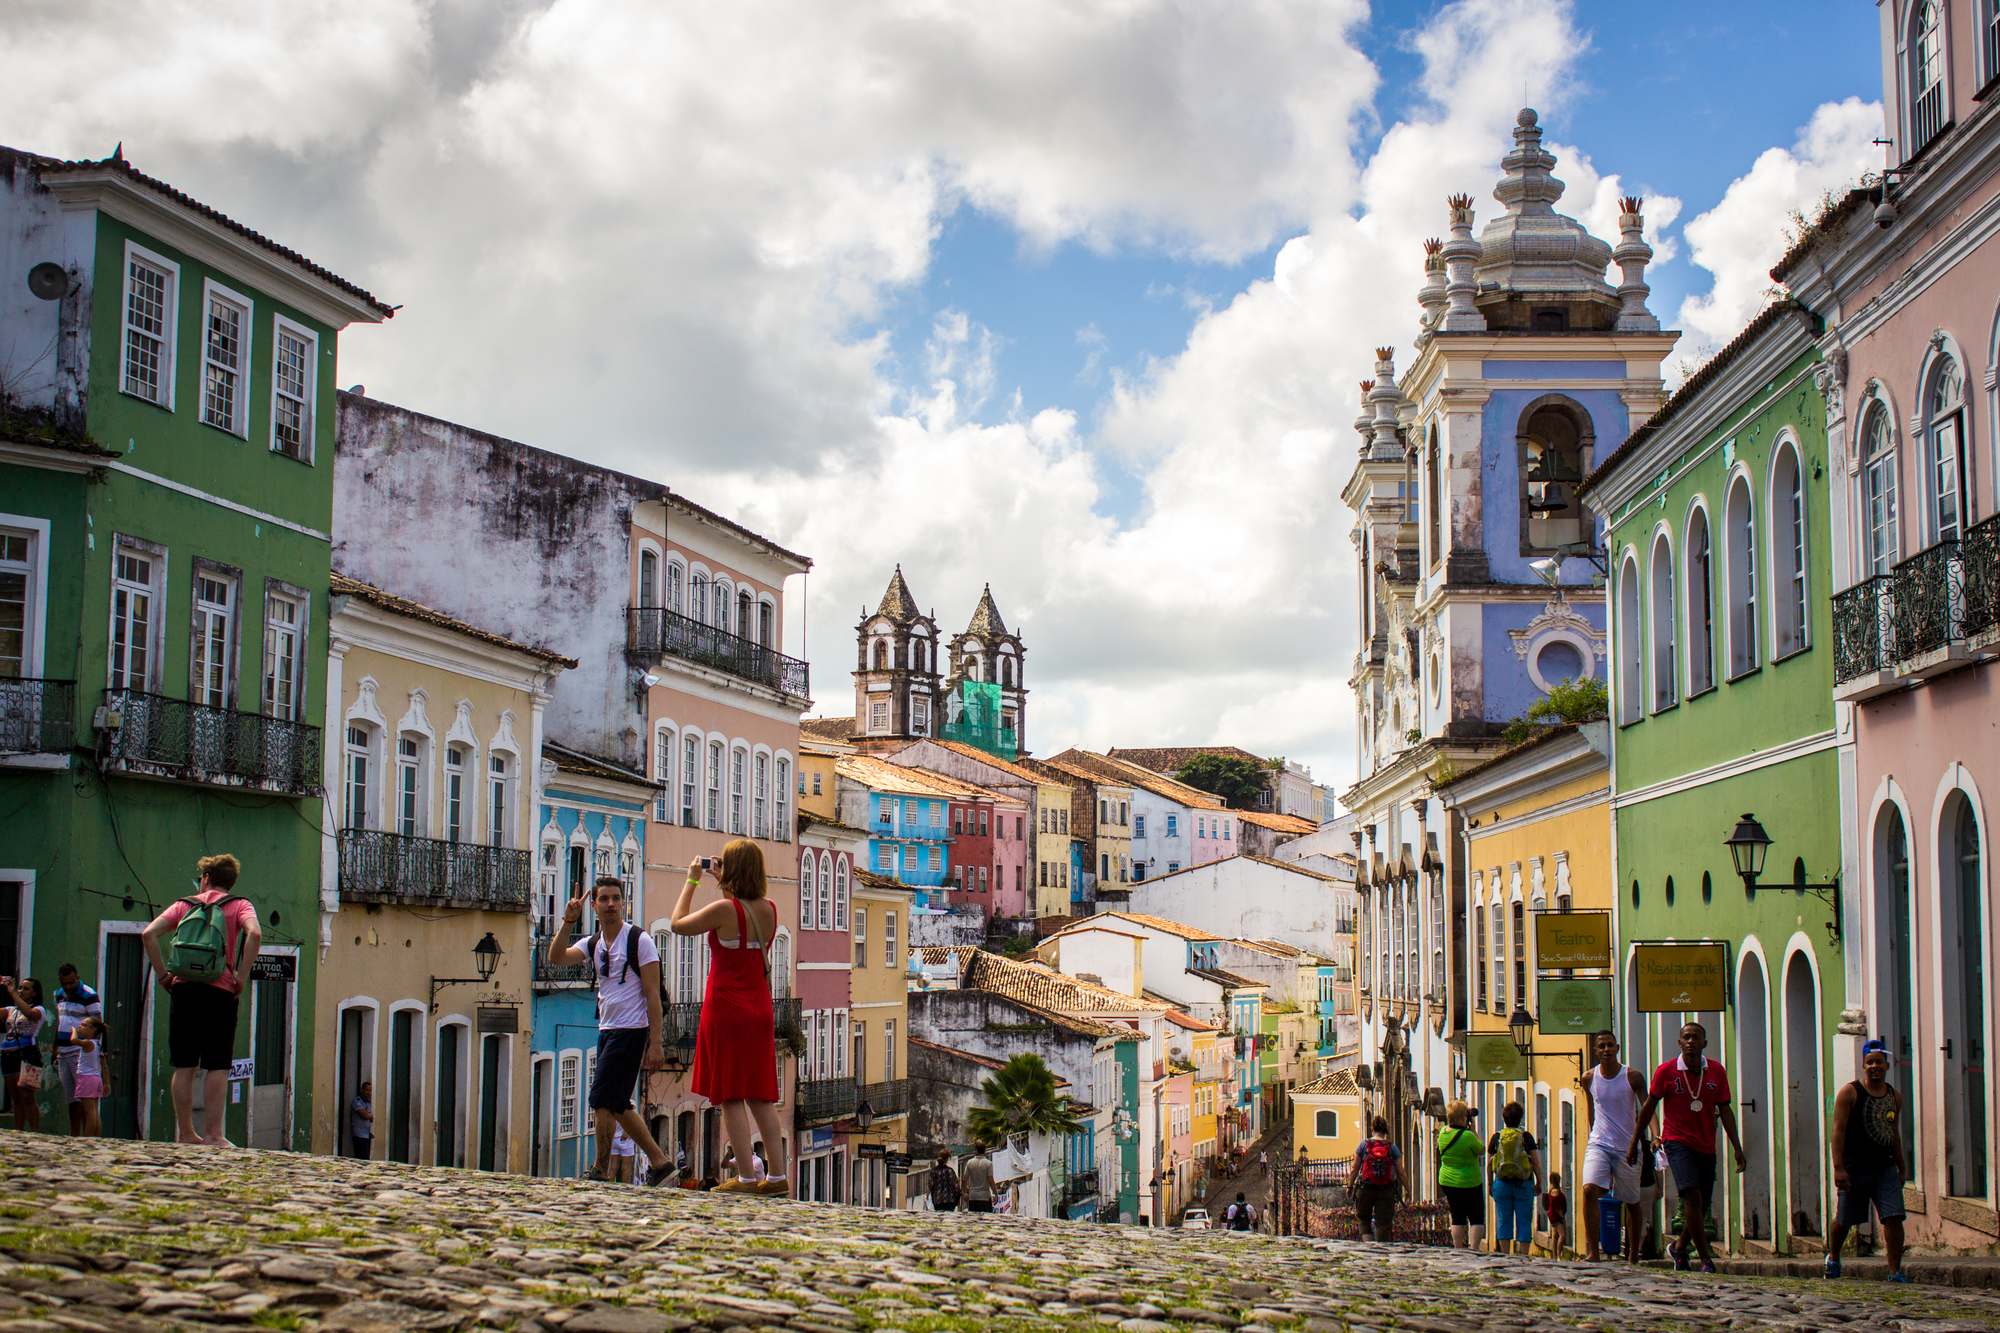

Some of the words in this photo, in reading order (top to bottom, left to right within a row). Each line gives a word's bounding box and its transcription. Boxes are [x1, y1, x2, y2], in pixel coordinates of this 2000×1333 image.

[1549, 929, 1595, 945] Teatro
[252, 963, 282, 972] TATTOO
[1646, 958, 1721, 975] Restaurante
[229, 1063, 254, 1077] AZAR
